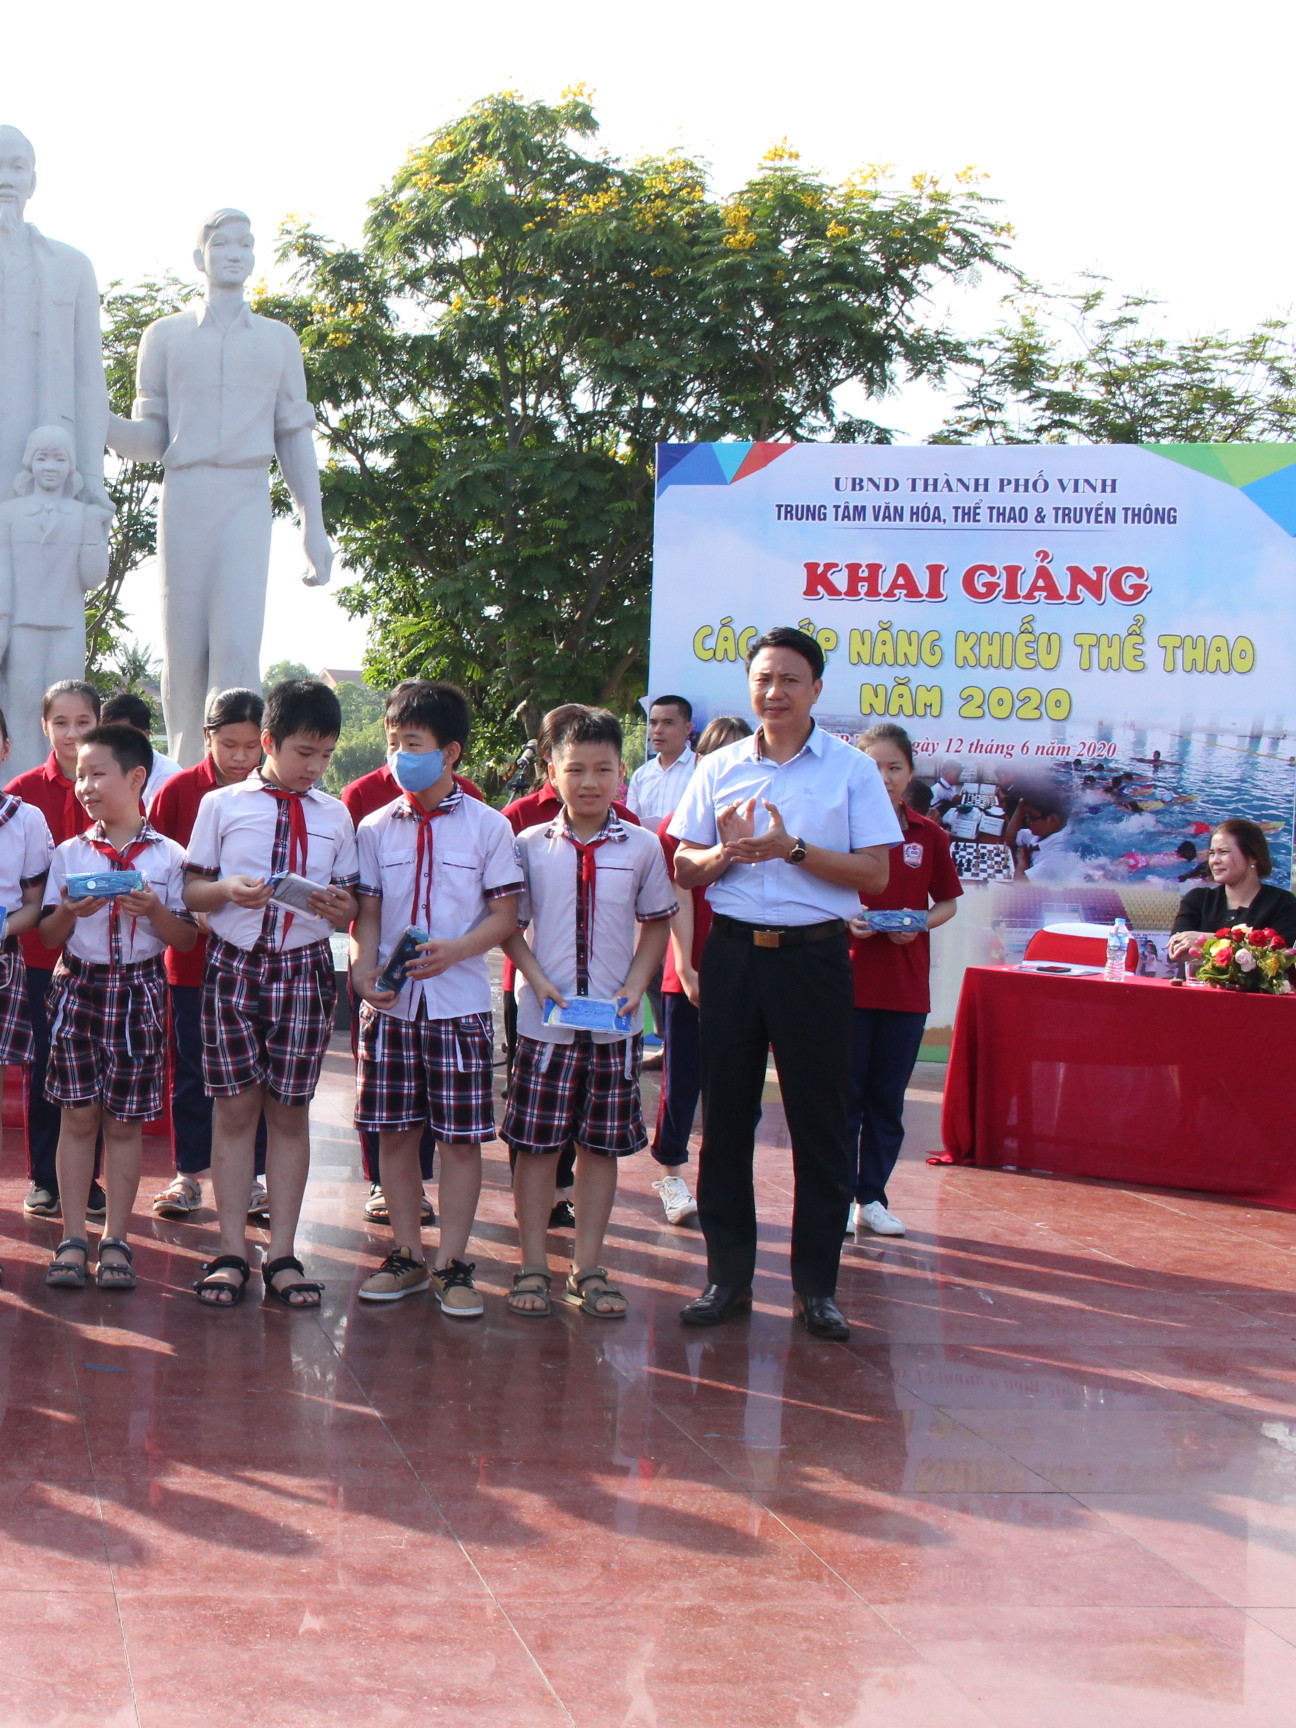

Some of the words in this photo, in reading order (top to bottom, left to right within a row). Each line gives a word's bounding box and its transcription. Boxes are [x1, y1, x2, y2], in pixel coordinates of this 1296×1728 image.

[833, 476, 900, 493] UBND
[906, 473, 991, 493] THÀNH
[997, 470, 1050, 493] PHỐ
[1057, 478, 1119, 494] VINH
[775, 504, 827, 521] TRUNG
[832, 501, 867, 522] TÂM
[872, 502, 904, 522] VĂN
[909, 502, 947, 525] HÓA,
[952, 499, 982, 523] THỂ
[987, 506, 1029, 523] THAO
[1034, 507, 1046, 523] &
[1052, 501, 1116, 524] TRUYỀN
[1122, 503, 1178, 524] THÔNG
[803, 562, 948, 602] KHAI
[962, 549, 1151, 606] GIẢNG
[849, 620, 943, 668] NĂNG
[955, 615, 1061, 670] KHIẾU
[1073, 614, 1146, 671] THỂ
[1157, 635, 1255, 674] THAO
[860, 677, 943, 718] NĂM
[958, 686, 1072, 720] 2020
[912, 736, 940, 757] gày
[945, 737, 963, 753] 12
[968, 738, 1015, 759] tháng
[1020, 739, 1030, 756] 6
[1035, 739, 1072, 757] năm
[1076, 741, 1118, 758] 2020
